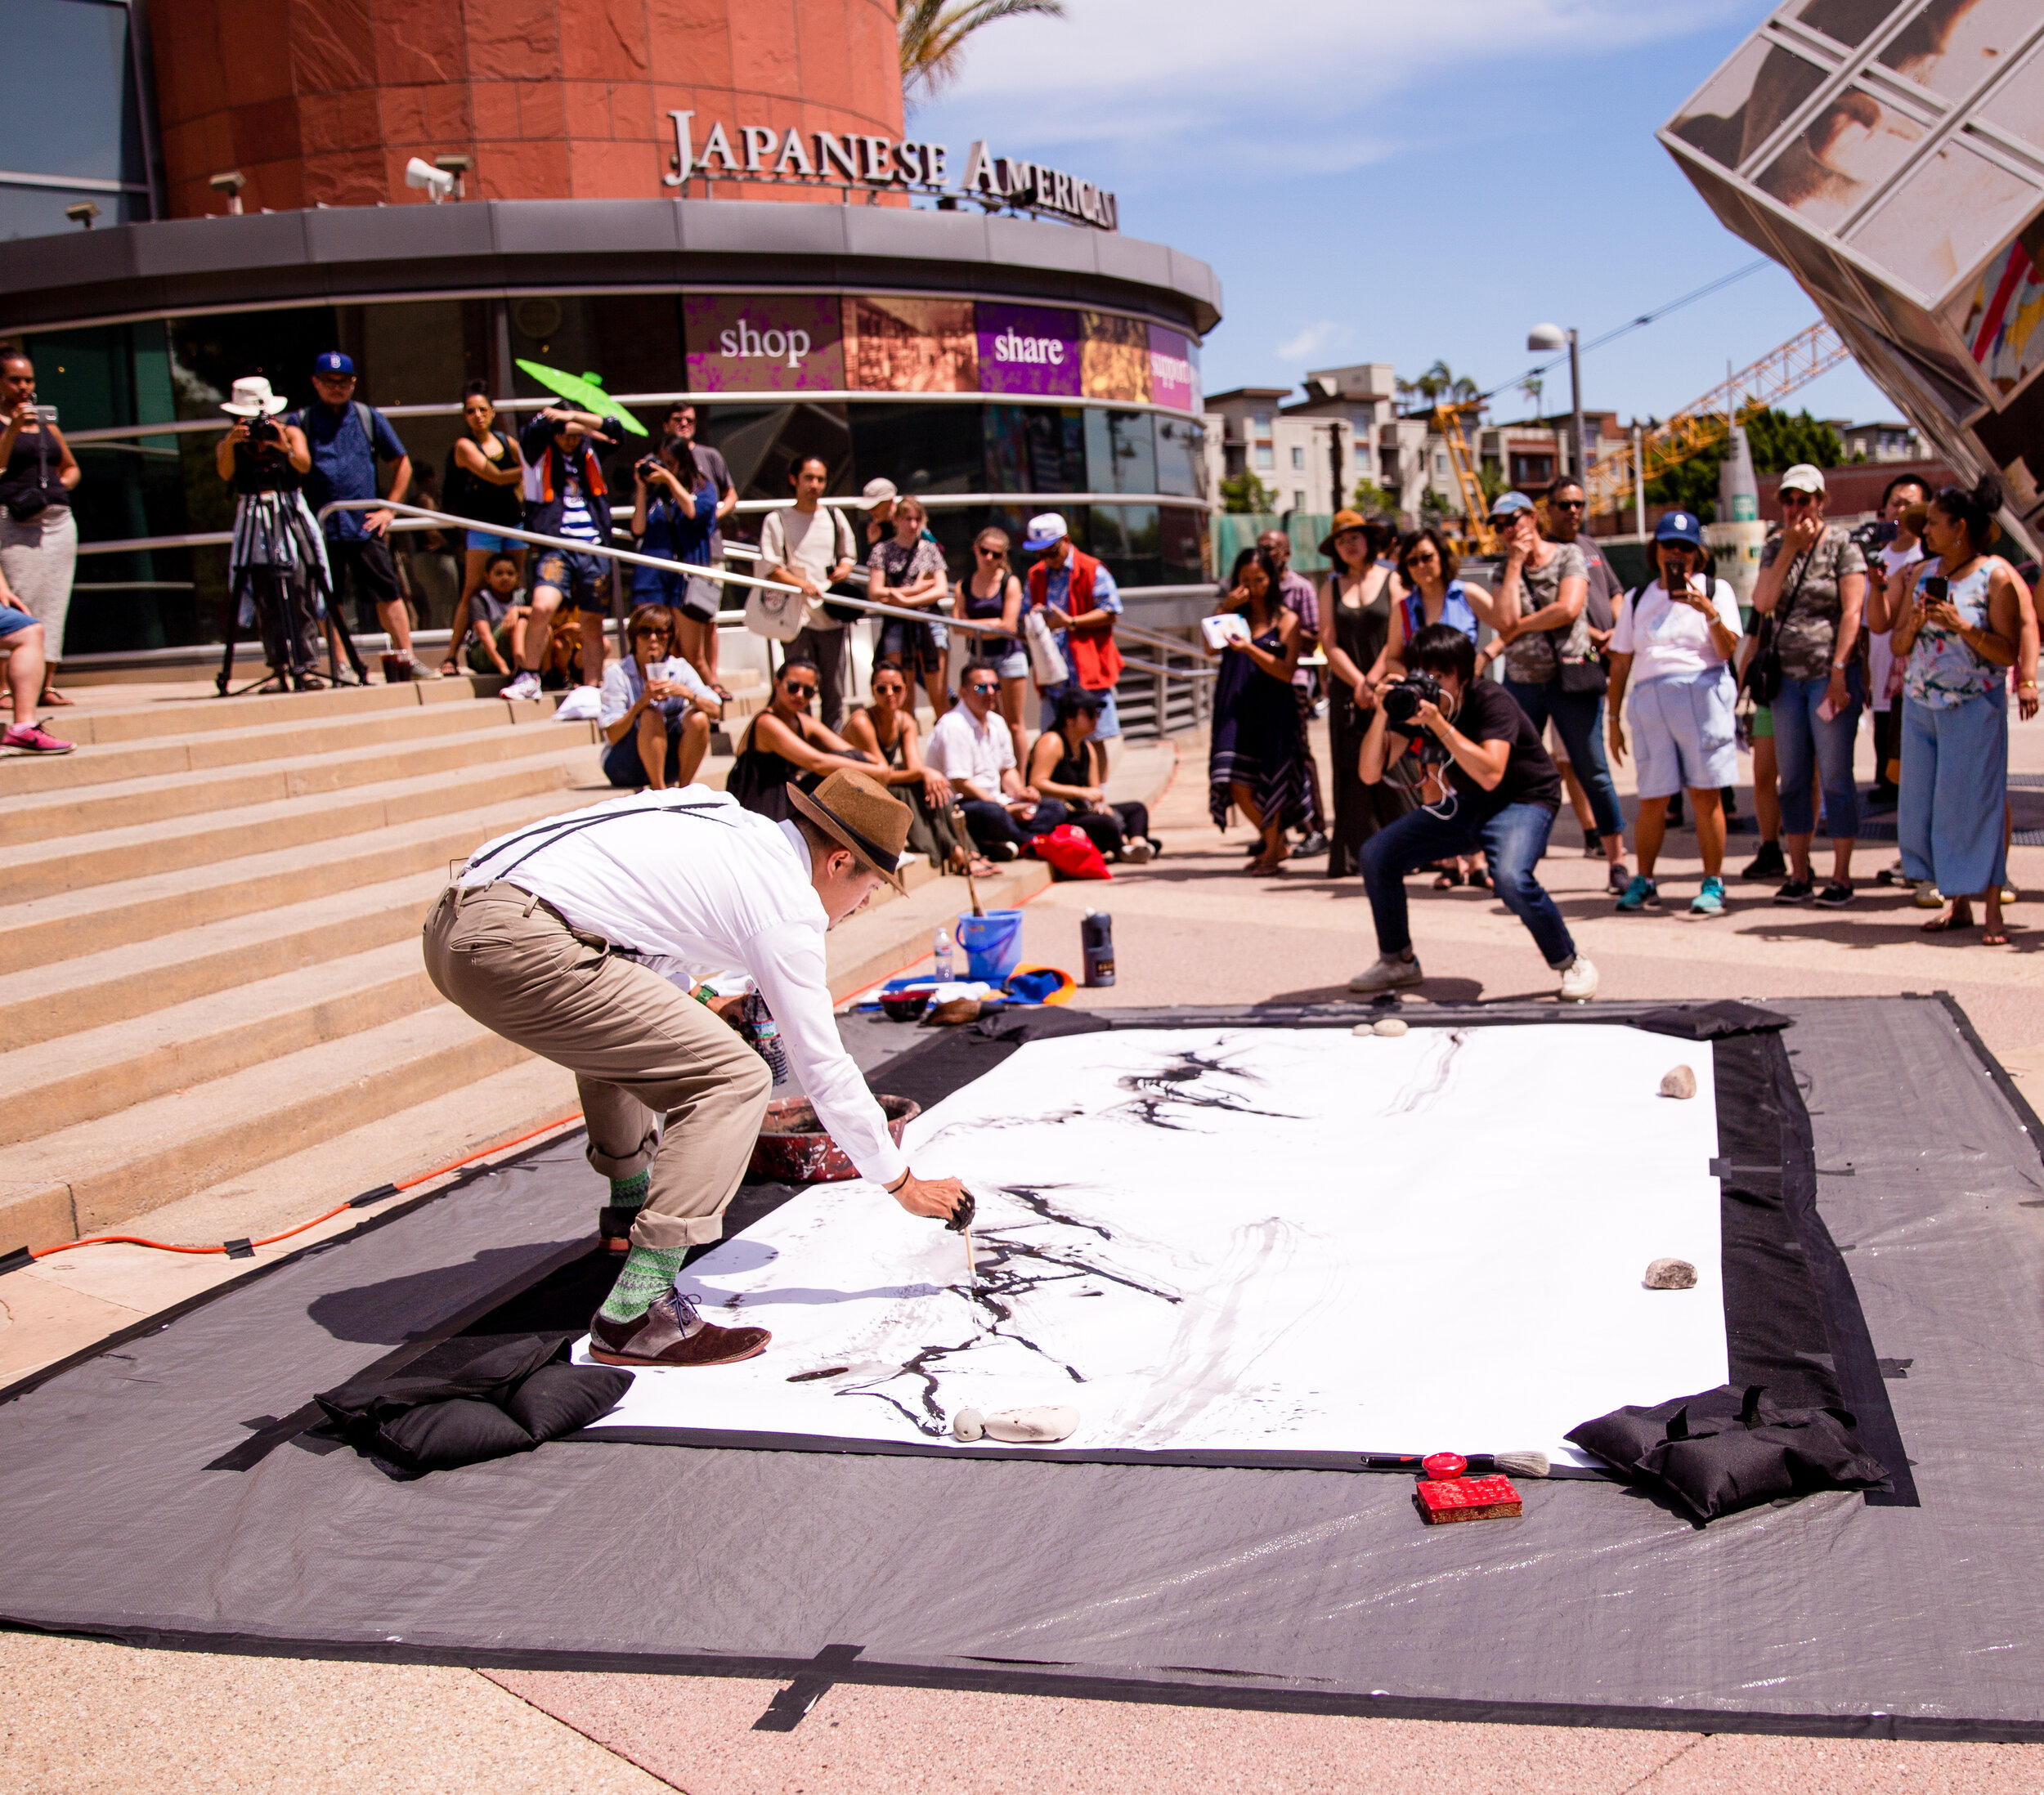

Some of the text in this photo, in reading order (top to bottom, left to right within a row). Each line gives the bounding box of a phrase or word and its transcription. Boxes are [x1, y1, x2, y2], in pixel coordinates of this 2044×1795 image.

[664, 110, 1118, 232] JAPANESE AMERICAN
[719, 319, 811, 369] shop
[995, 326, 1064, 365] share
